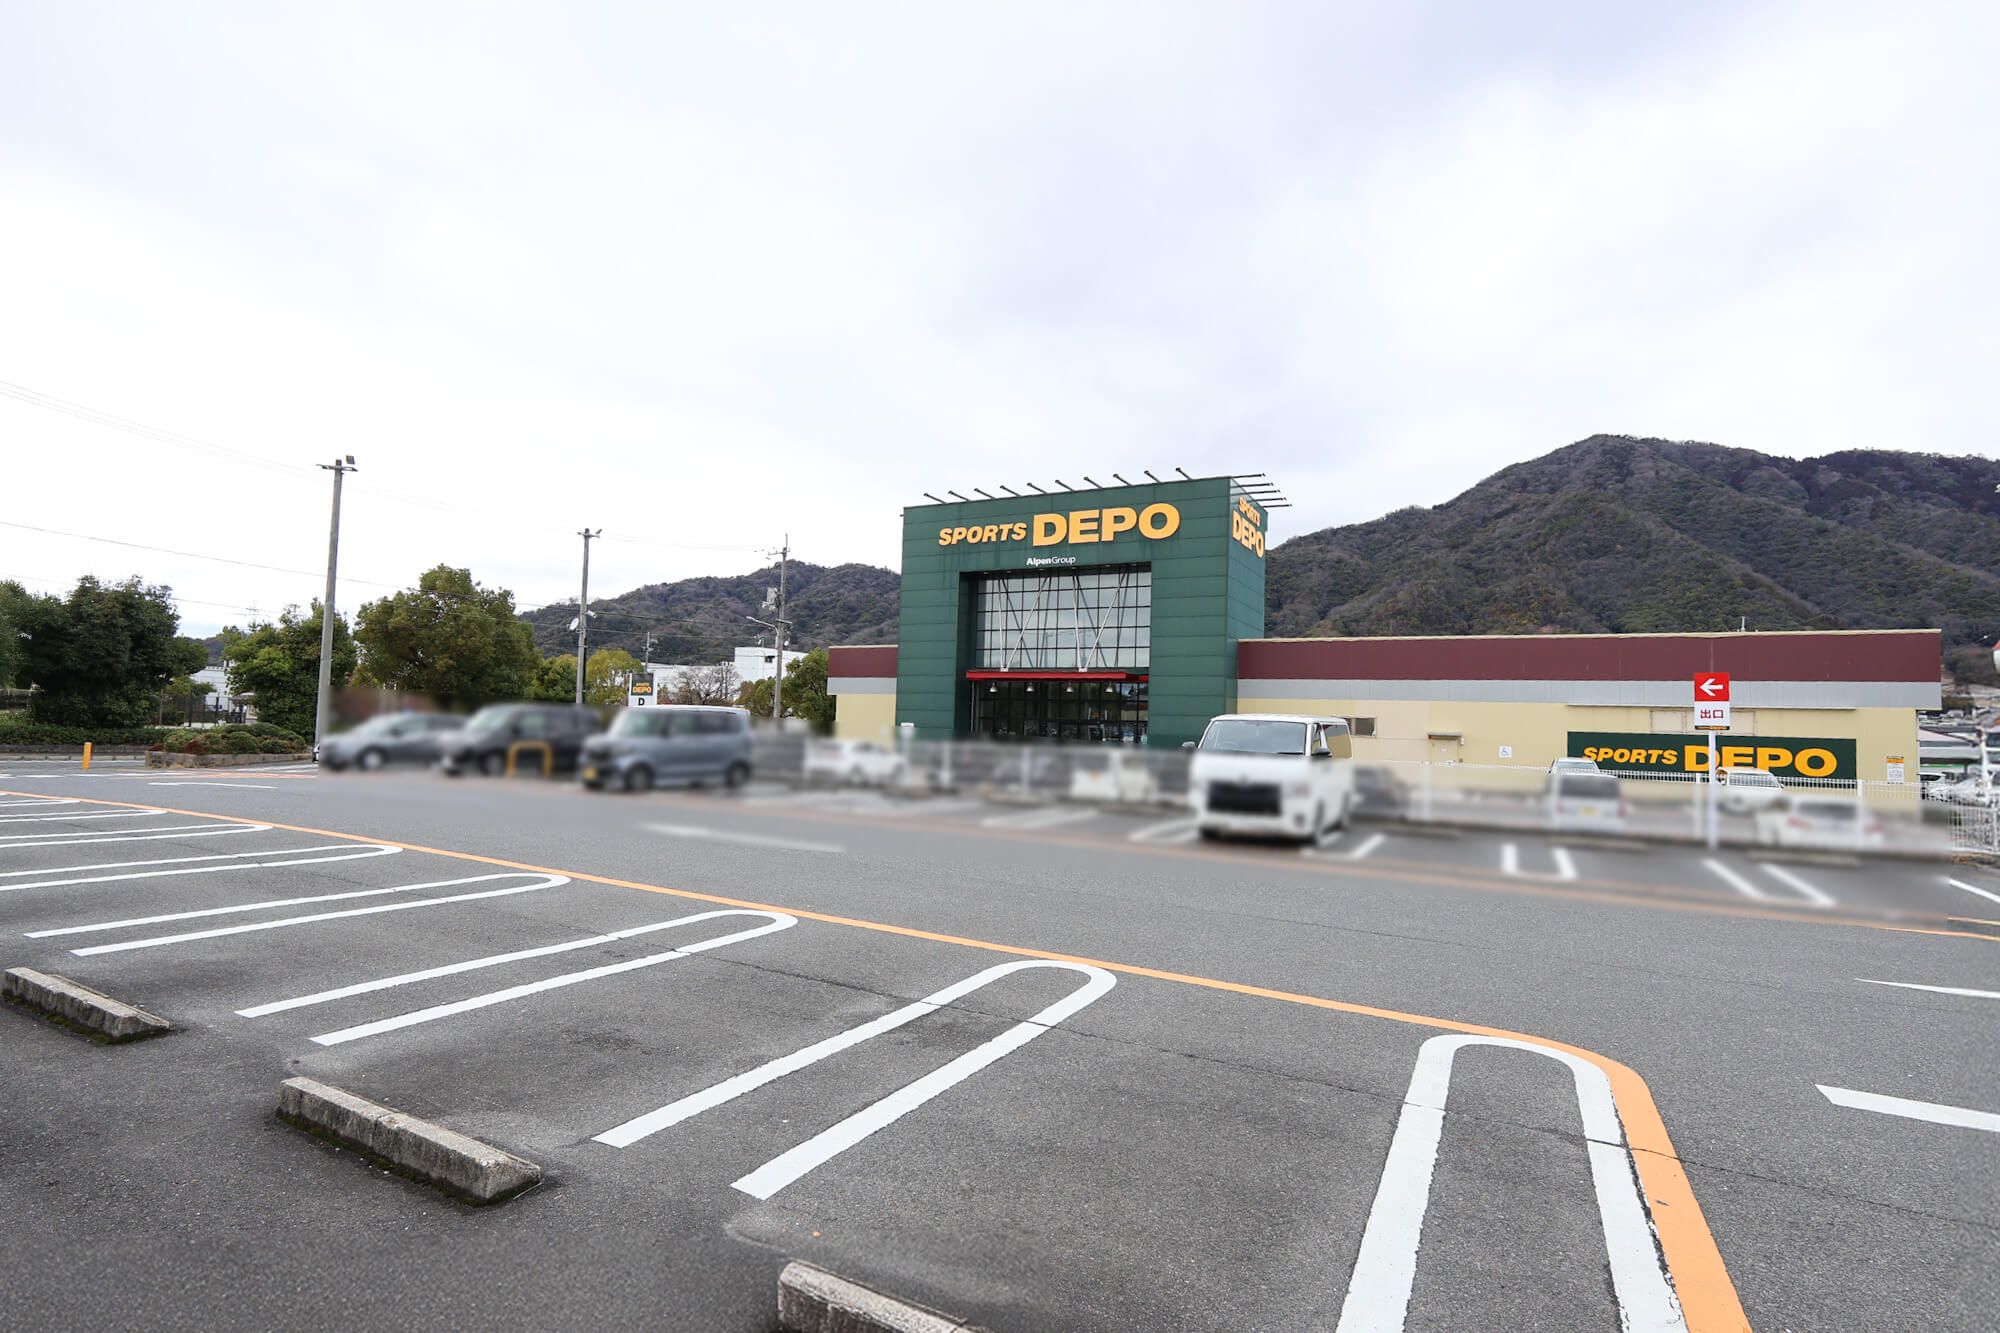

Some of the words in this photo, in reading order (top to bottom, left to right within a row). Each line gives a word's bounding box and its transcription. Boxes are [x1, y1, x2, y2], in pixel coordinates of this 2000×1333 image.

[938, 522, 1027, 546] SPORTS
[1033, 503, 1180, 546] DEPO
[1232, 510, 1264, 558] DEPO
[1700, 709, 1724, 719] 出口
[1583, 747, 1678, 765] SPORTS
[1684, 745, 1837, 777] DEPO
